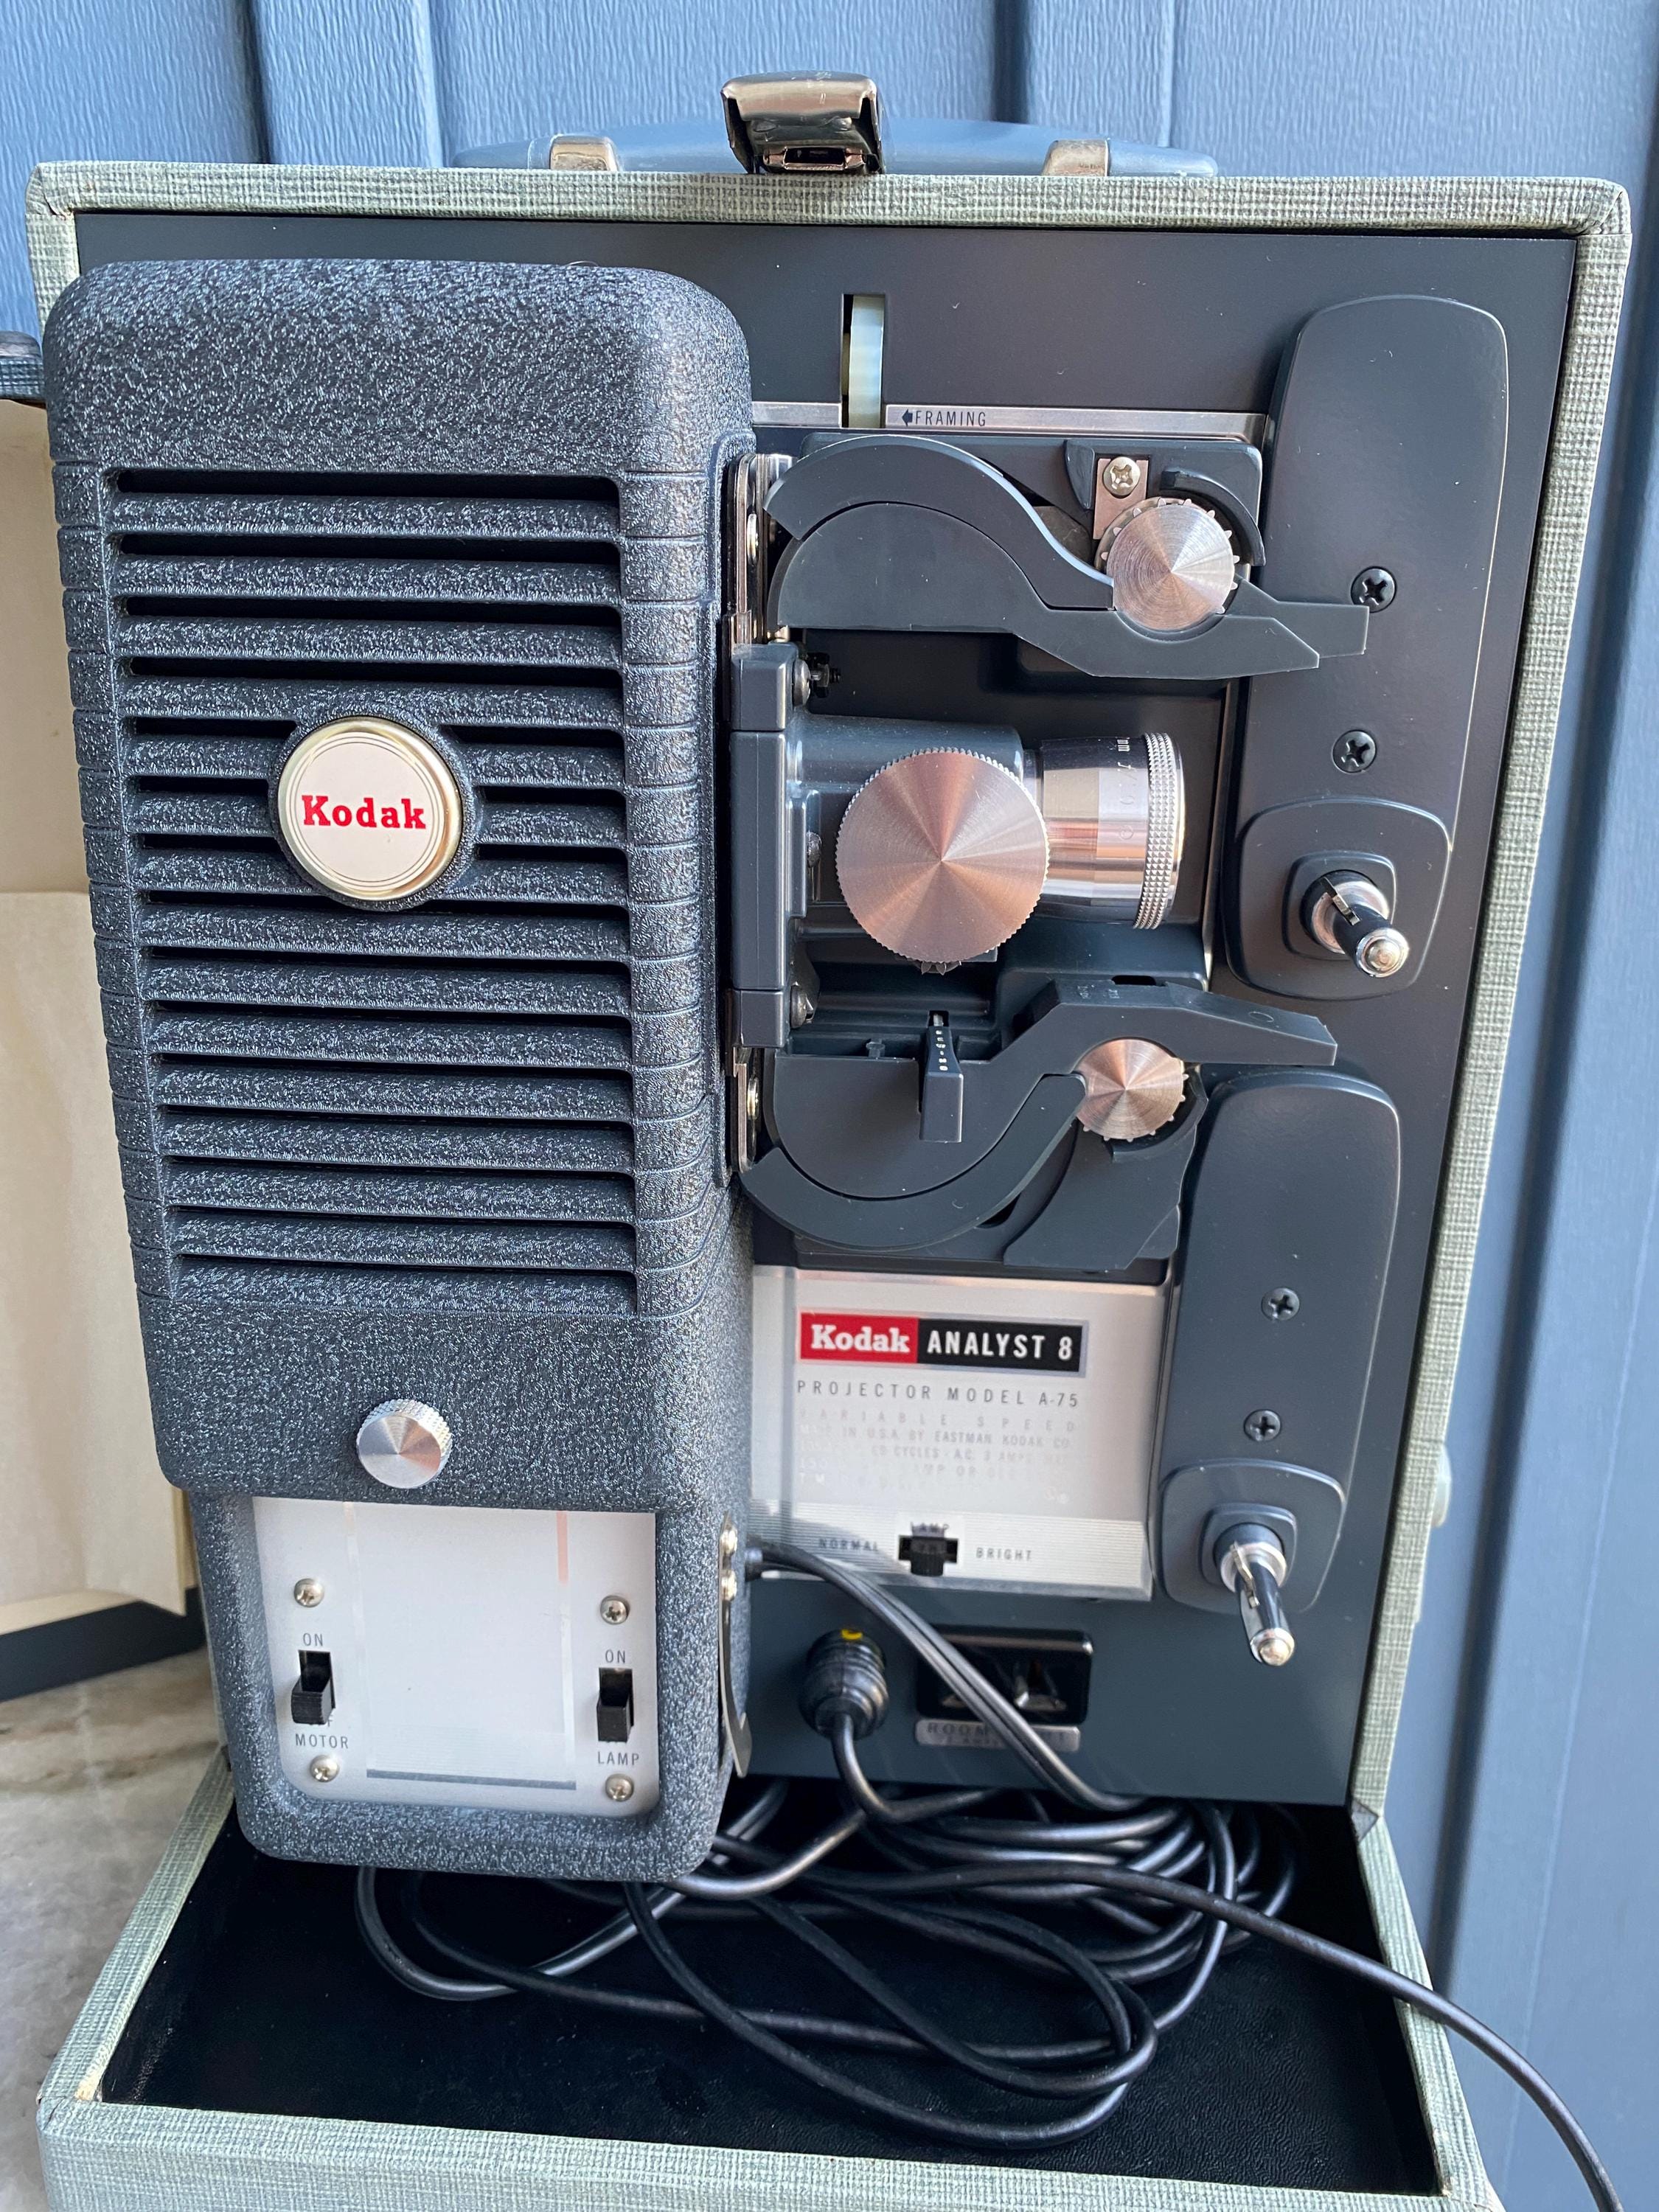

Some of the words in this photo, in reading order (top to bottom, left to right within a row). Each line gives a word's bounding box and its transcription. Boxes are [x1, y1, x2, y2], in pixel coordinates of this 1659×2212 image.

[915, 410, 986, 427] FRAMING
[301, 794, 427, 830] Kodak
[810, 1323, 911, 1354] Kodak
[926, 1329, 1046, 1360] ANALYST
[1057, 1335, 1073, 1360] 8
[797, 1380, 931, 1399] PROJECTOR
[947, 1387, 1024, 1405] MODEL
[1038, 1392, 1078, 1408] A-75
[800, 1408, 947, 1426] VARIABLE
[977, 1416, 1075, 1433] SPEED
[934, 1430, 993, 1444] EASTMAN
[1002, 1434, 1044, 1447] KODAK
[818, 1537, 879, 1552] NORMAL
[975, 1546, 1032, 1561] BRIGHT
[302, 1632, 324, 1646] ON
[604, 1649, 626, 1664] ON
[295, 1733, 349, 1749] MOTOR
[597, 1751, 640, 1767] LAMP
